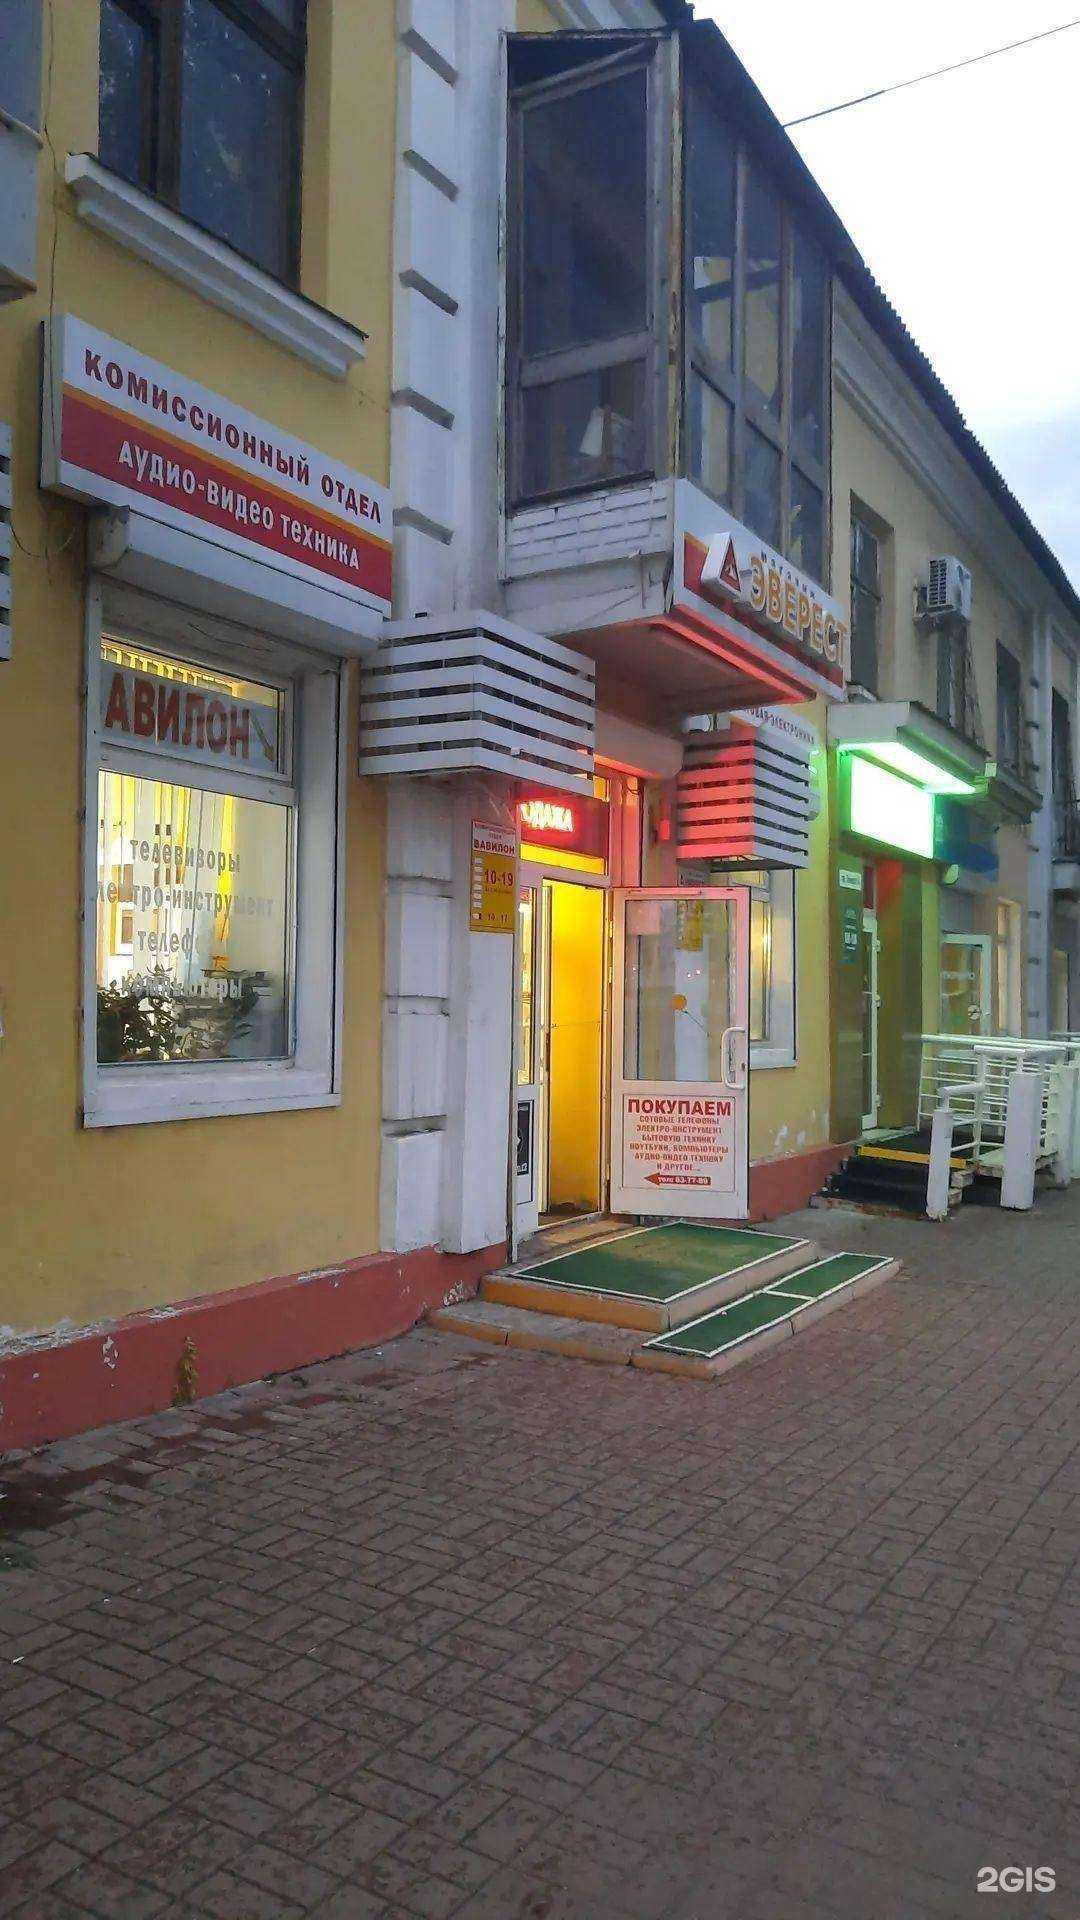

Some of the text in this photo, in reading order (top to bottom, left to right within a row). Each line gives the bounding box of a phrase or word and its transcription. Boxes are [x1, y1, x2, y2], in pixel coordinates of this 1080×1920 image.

[84, 348, 382, 524] КОМИССИОННЫЙ ОТДЕЛ
[749, 555, 848, 668] ЭВЕРЕСТ
[473, 839, 515, 854] ВАВИЛОН
[130, 839, 241, 876] телевизоры
[485, 868, 514, 887] 10-19
[628, 1099, 731, 1116] ПОКУПАЕМ
[639, 1115, 720, 1126] СОТОВЫЕ ТЕЛЕФОНЫ
[642, 1134, 717, 1144] БЫТОВУЮ ТЕХНИКУ
[673, 1144, 729, 1154] КОМПЬЮТЕРЫ
